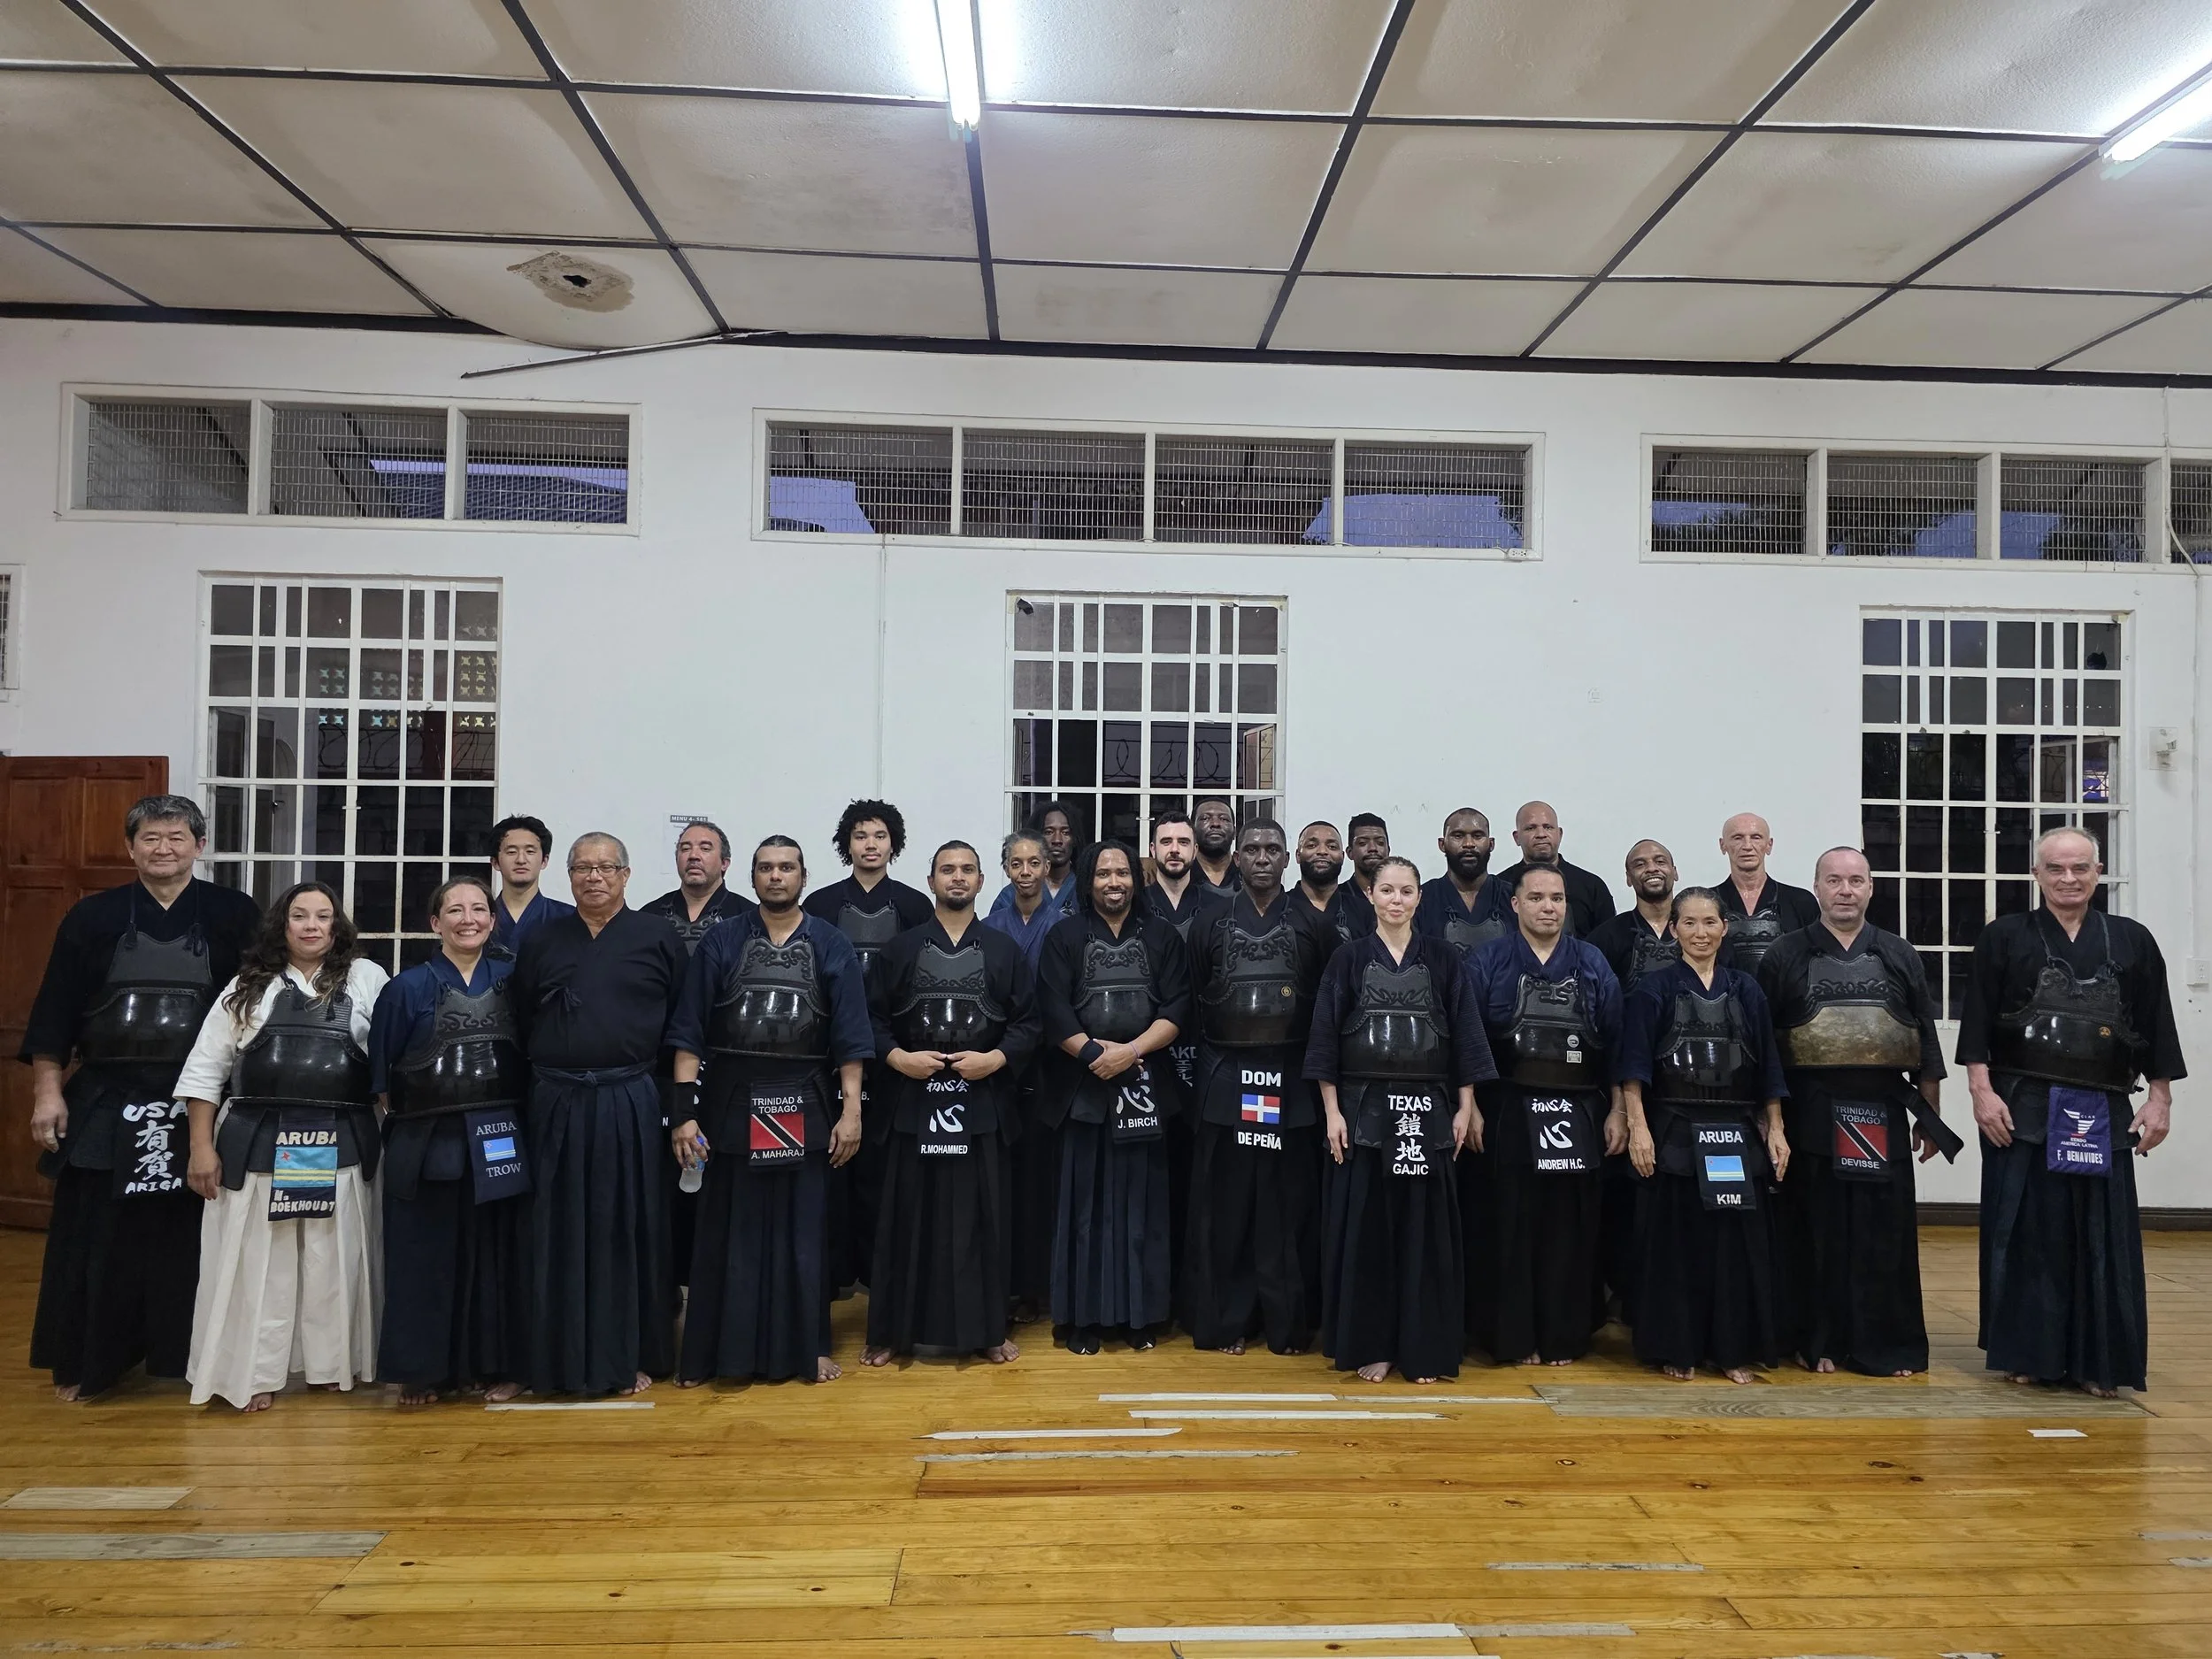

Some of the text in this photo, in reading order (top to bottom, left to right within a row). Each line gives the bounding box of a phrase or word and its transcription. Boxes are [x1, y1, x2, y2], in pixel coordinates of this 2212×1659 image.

[1241, 1070, 1281, 1087] DOM
[926, 1079, 969, 1093] 初心会
[751, 1095, 803, 1106] TRINIDAD &
[1387, 1094, 1432, 1111] TEXAS
[1532, 1098, 1573, 1113] 初心会
[123, 1102, 188, 1122] USA
[758, 1104, 798, 1114] TOBAGO
[1833, 1105, 1878, 1117] TRINIDAD
[929, 1103, 965, 1133] 心
[1118, 1116, 1158, 1129] J. BIRCH
[1841, 1114, 1881, 1125] TOBAGO
[475, 1121, 518, 1136] ARUBA
[1540, 1120, 1573, 1149] 心
[275, 1131, 337, 1146] ARUBA
[1238, 1131, 1282, 1150] DE PEÑA
[1699, 1131, 1744, 1144] ARUBA
[134, 1119, 175, 1181] 有賀
[751, 1148, 805, 1160] A. MAHARAJ
[920, 1144, 968, 1155] R.MOHAMMED
[2057, 1149, 2103, 1164] F. BENAVIDES
[1393, 1164, 1429, 1176] GAJIC
[1538, 1157, 1586, 1170] ANDREW H.C.
[1841, 1157, 1881, 1169] DEVISSE
[486, 1163, 522, 1178] TROW
[125, 1177, 182, 1194] ARIGA
[270, 1200, 335, 1213] BOEKHOUDT
[1717, 1194, 1742, 1205] KIM
